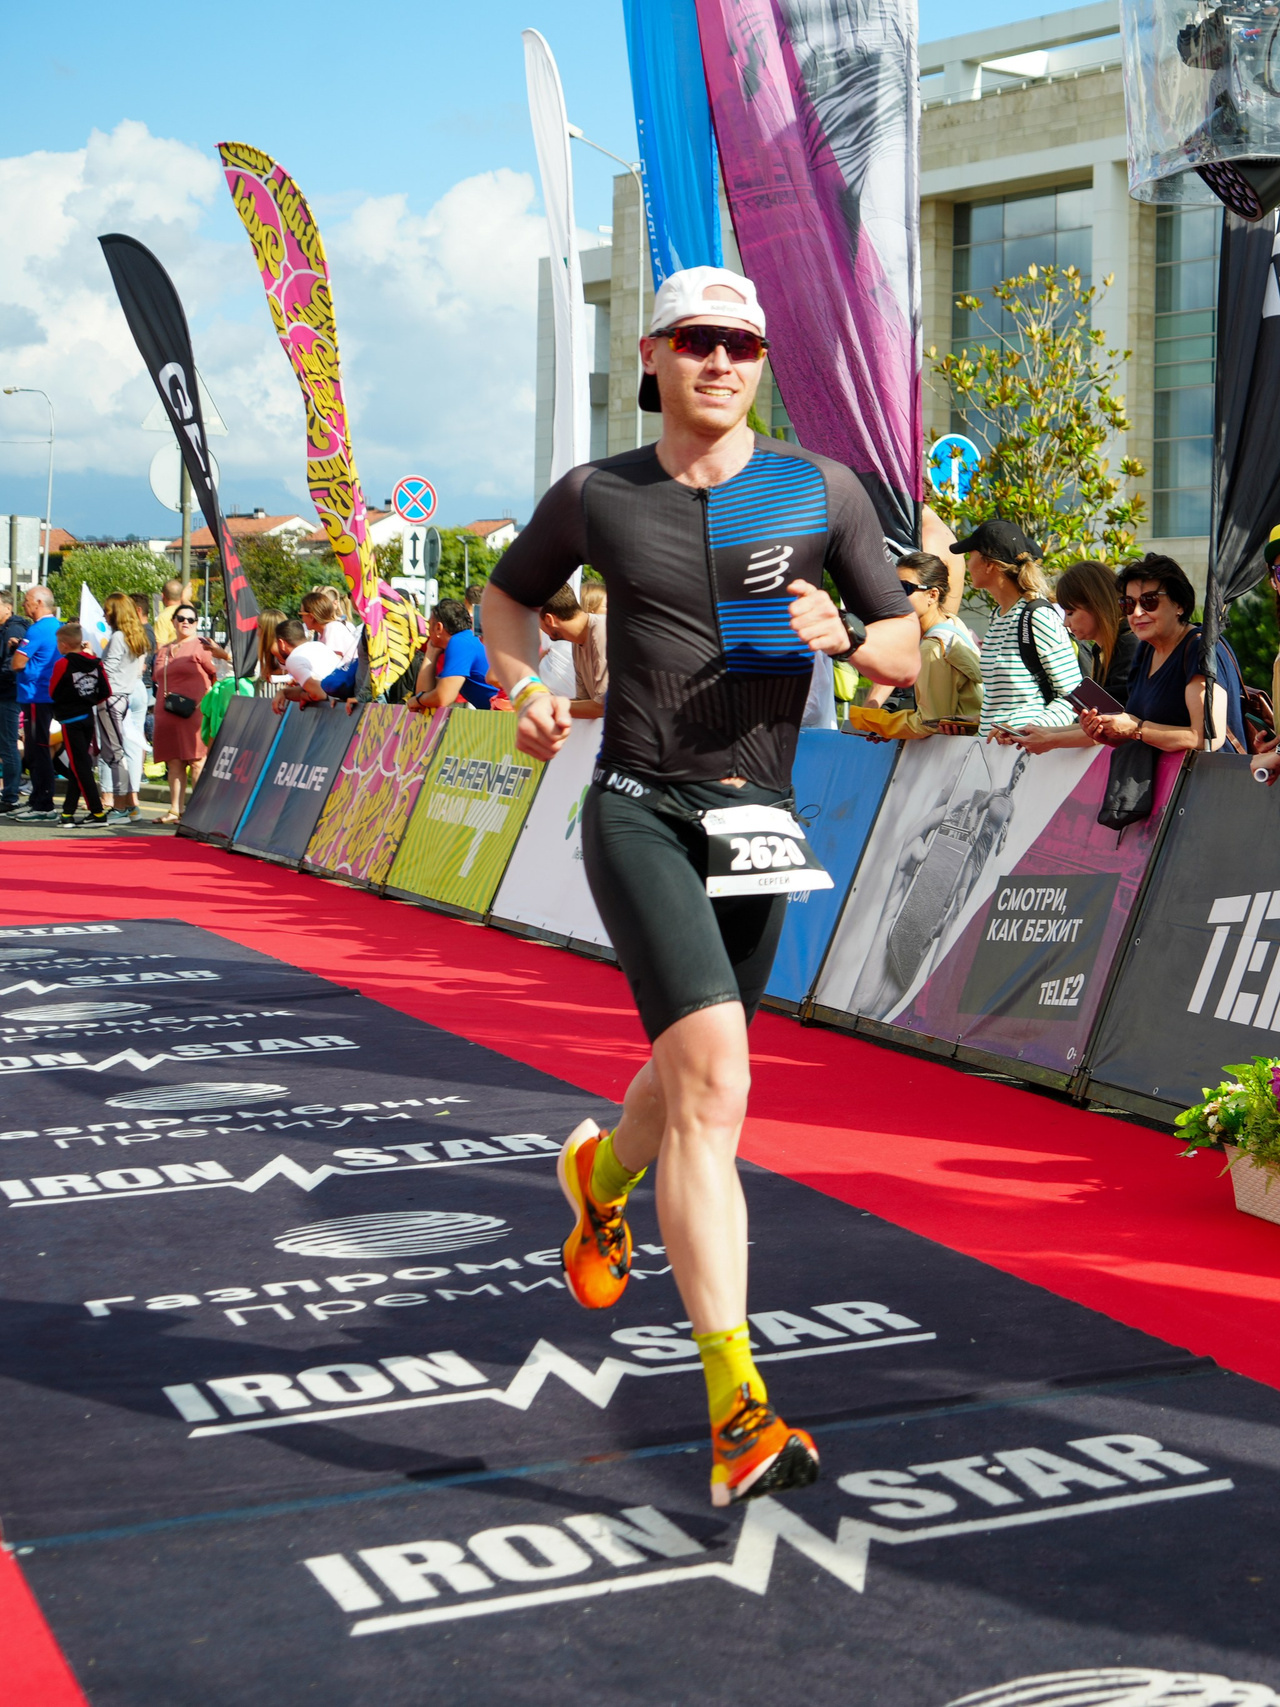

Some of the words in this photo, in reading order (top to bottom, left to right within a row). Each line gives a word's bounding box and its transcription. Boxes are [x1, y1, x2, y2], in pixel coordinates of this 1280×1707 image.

[1022, 610, 1031, 644] IRONSTAR
[435, 755, 533, 799] FAHRENHEIT
[758, 873, 791, 886] СЕРГЕЙ
[997, 887, 1068, 915] СМОТРИ,
[986, 918, 1023, 942] КАК
[1022, 918, 1084, 943] БЕЖИТ
[66, 970, 221, 985] STAR
[1038, 973, 1085, 1006] TELE2
[170, 1035, 357, 1057] STAR
[0, 1160, 234, 1200] IRON
[332, 1133, 563, 1167] STAR
[162, 1350, 490, 1423] IRON
[304, 1505, 708, 1612] IRON
[836, 1433, 1208, 1521] STAR
